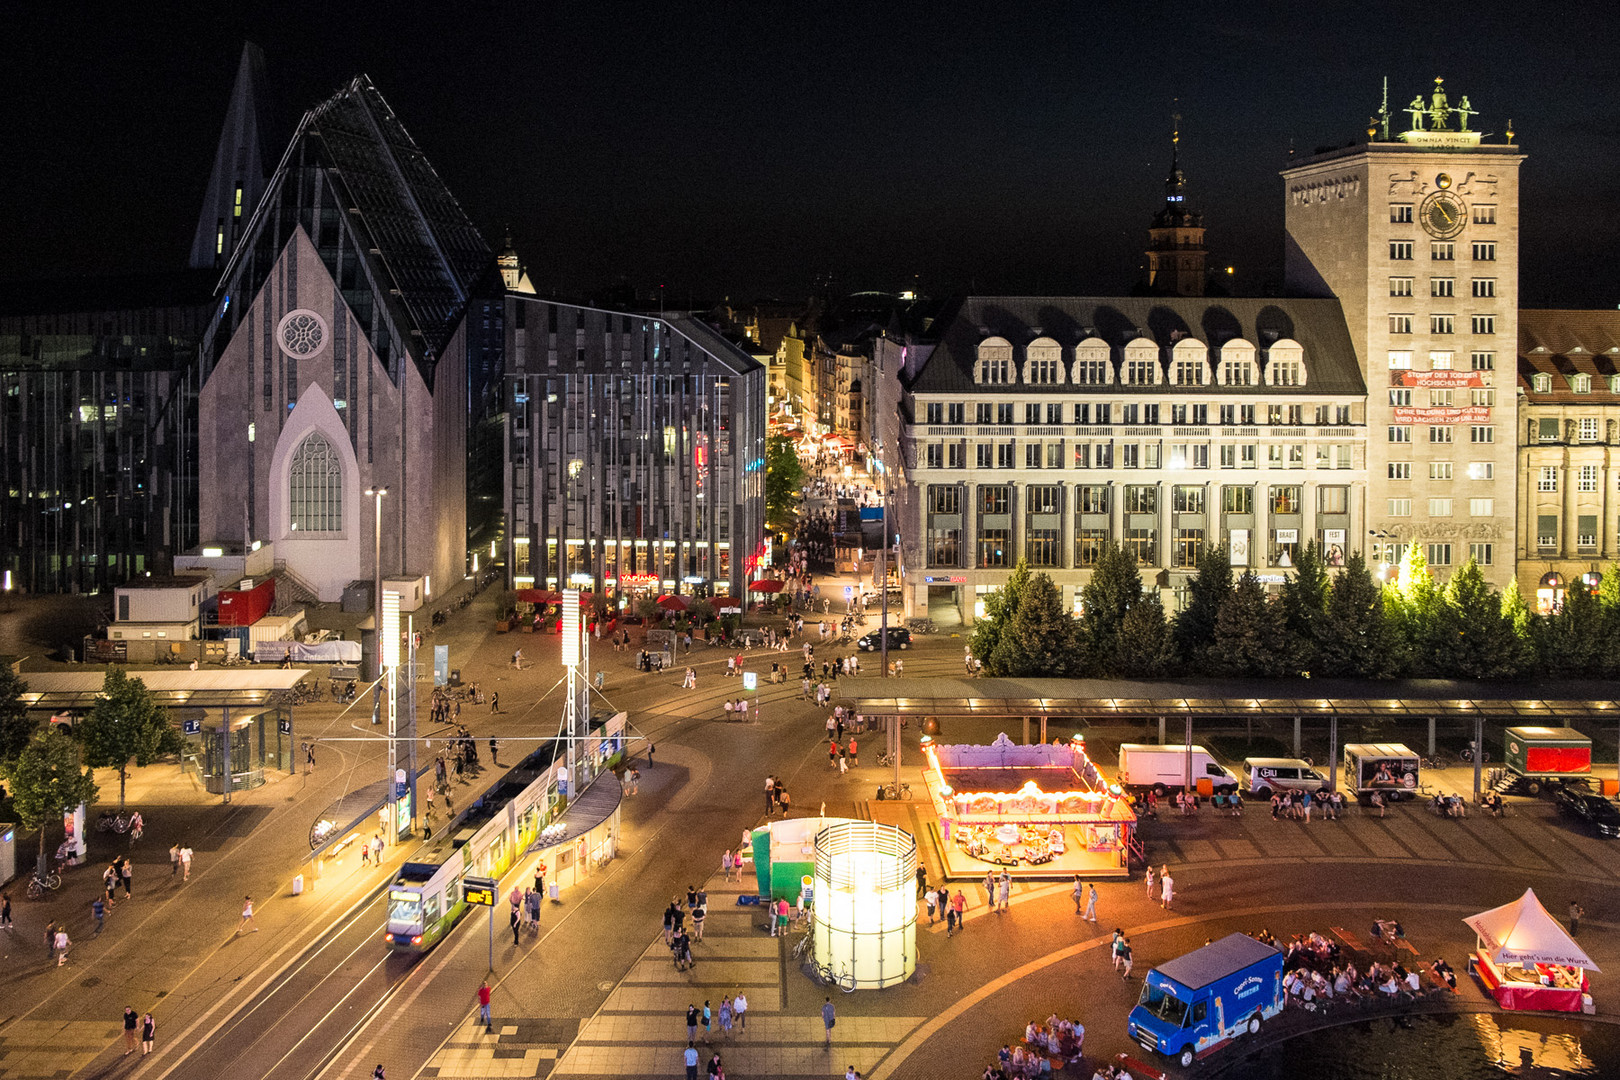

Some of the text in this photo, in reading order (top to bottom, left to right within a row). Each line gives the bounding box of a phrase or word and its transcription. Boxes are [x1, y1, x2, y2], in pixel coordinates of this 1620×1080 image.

[193, 721, 199, 730] P
[285, 722, 290, 730] P
[1234, 976, 1263, 995] Capri-Sonne
